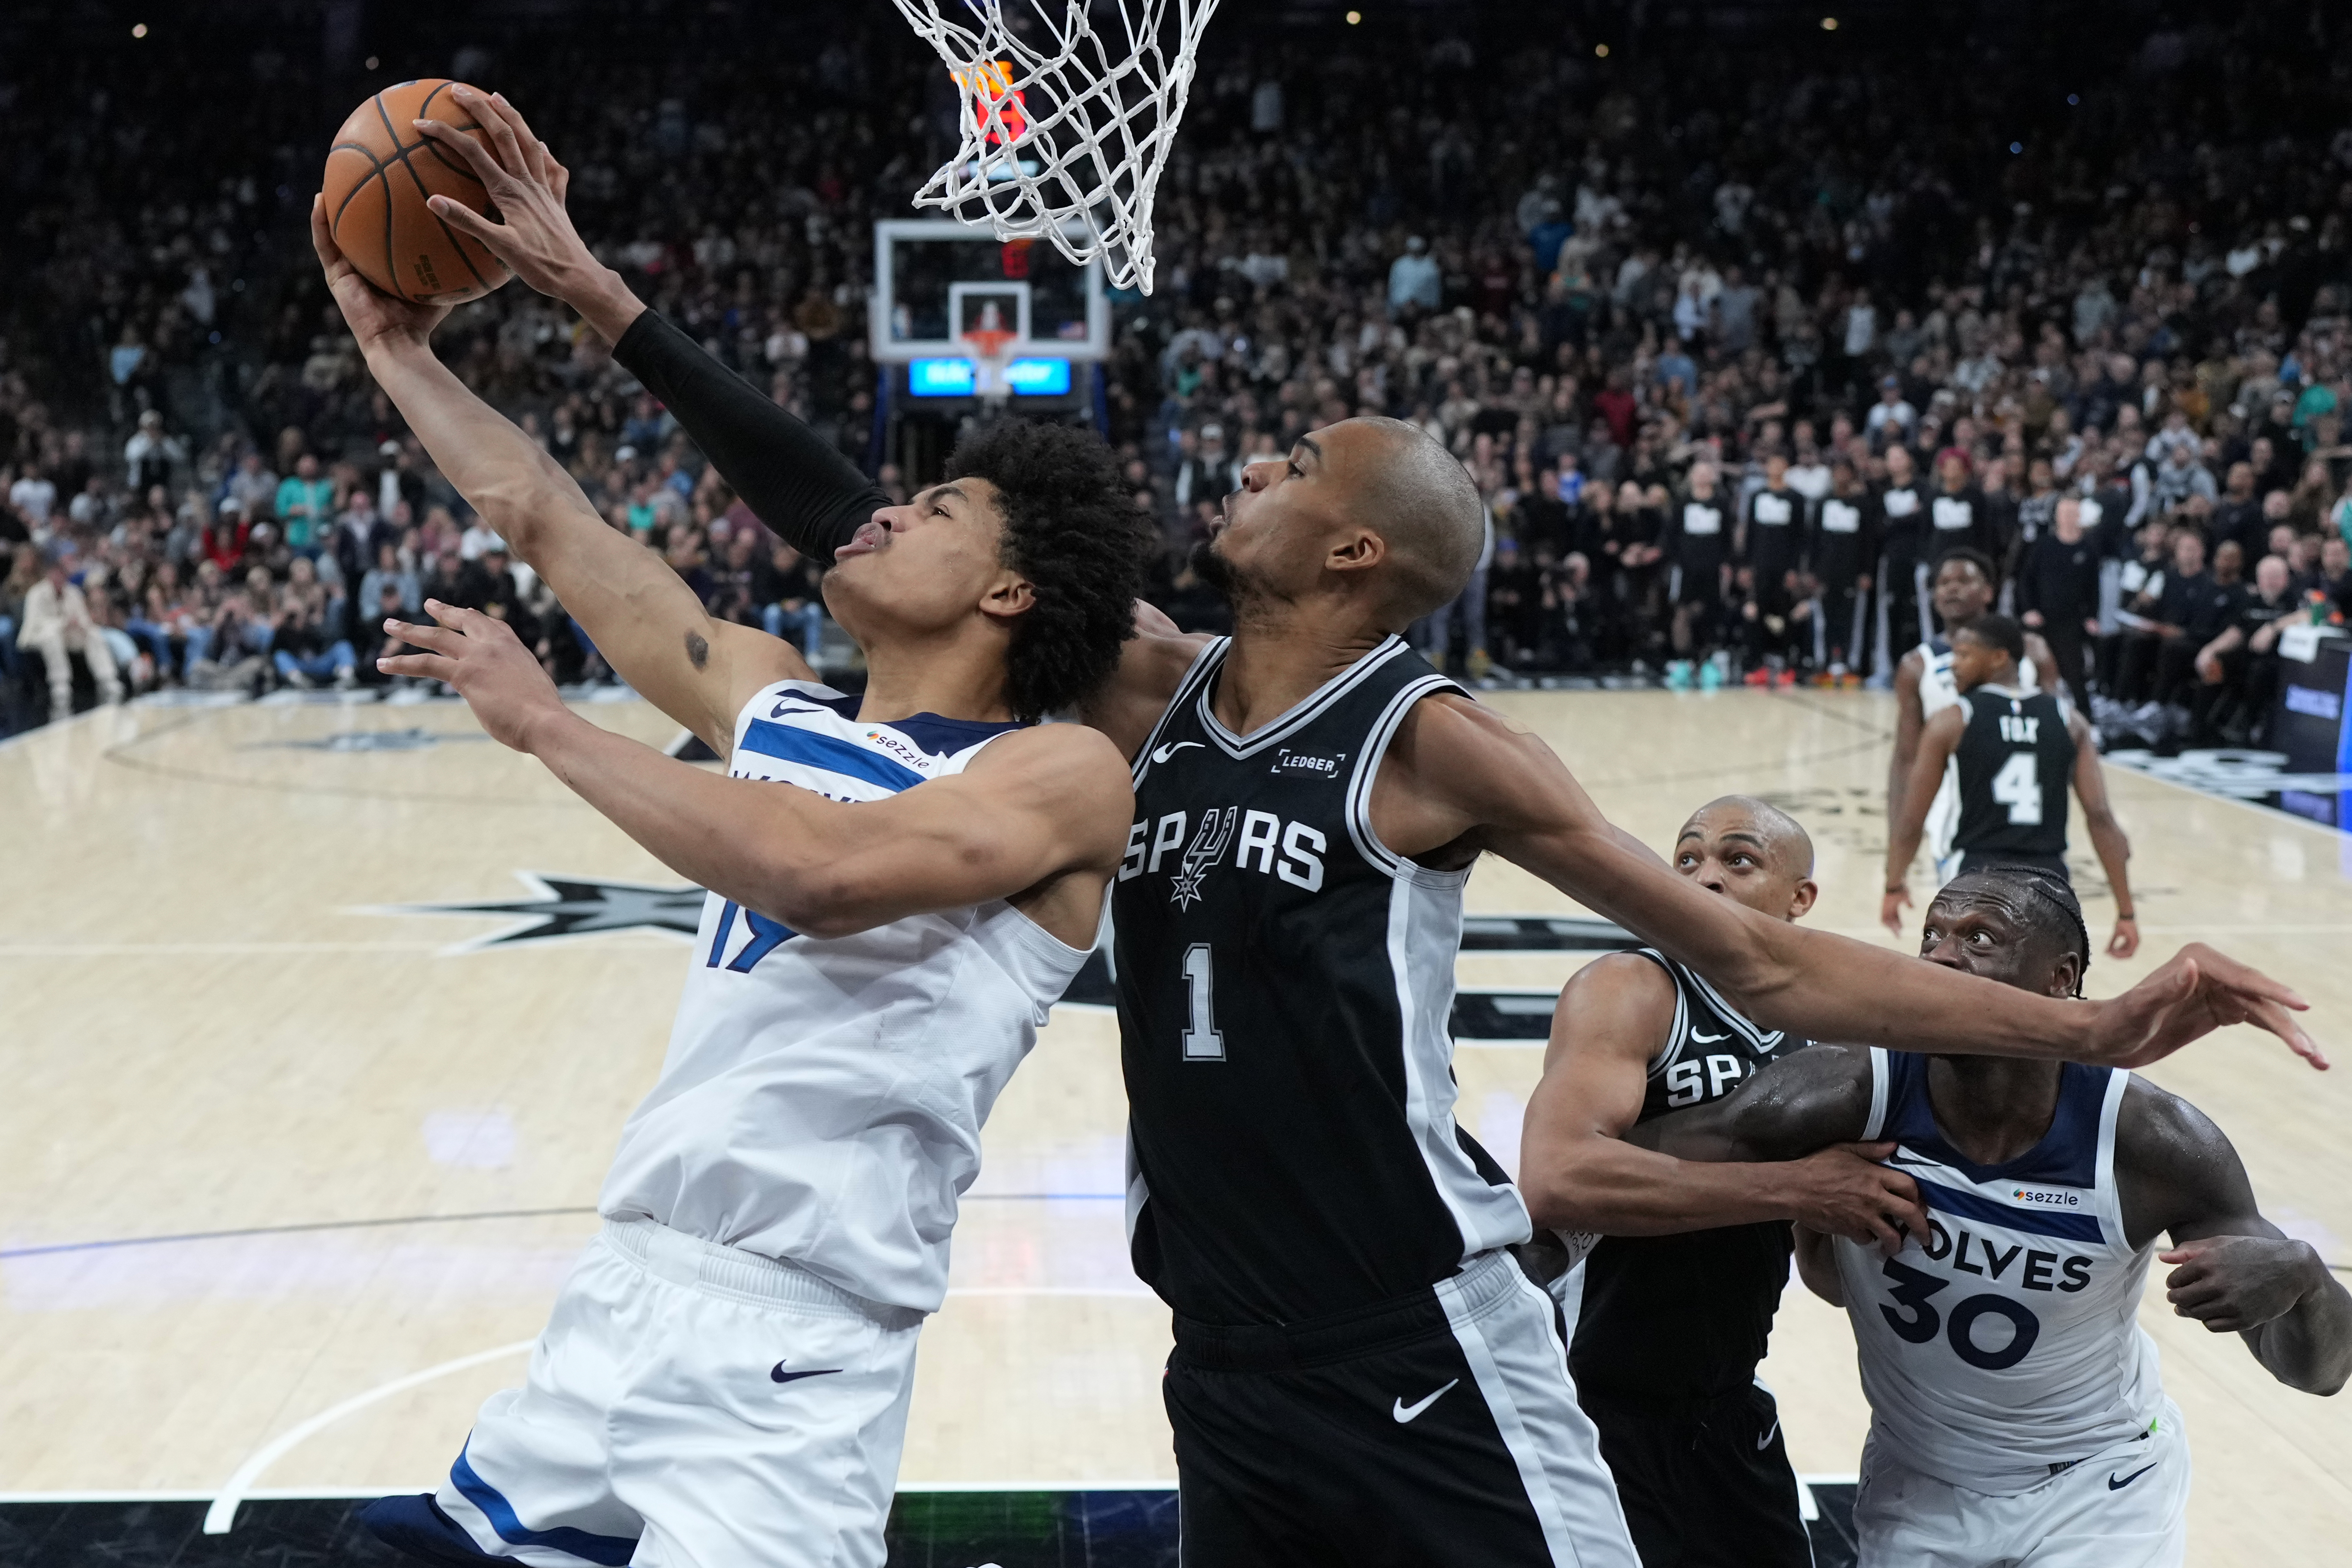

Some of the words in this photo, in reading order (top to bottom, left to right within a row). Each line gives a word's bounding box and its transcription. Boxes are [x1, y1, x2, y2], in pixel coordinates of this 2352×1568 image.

[876, 737, 929, 768] sezzle
[1282, 756, 1335, 771] LEDGER
[1993, 752, 2043, 825] 4
[1118, 806, 1327, 913] SPURS
[1182, 943, 1226, 1062] 1
[2025, 1192, 2078, 1205] sezzle
[1899, 1219, 2093, 1293] OLVES
[1879, 1256, 2040, 1370] 30
